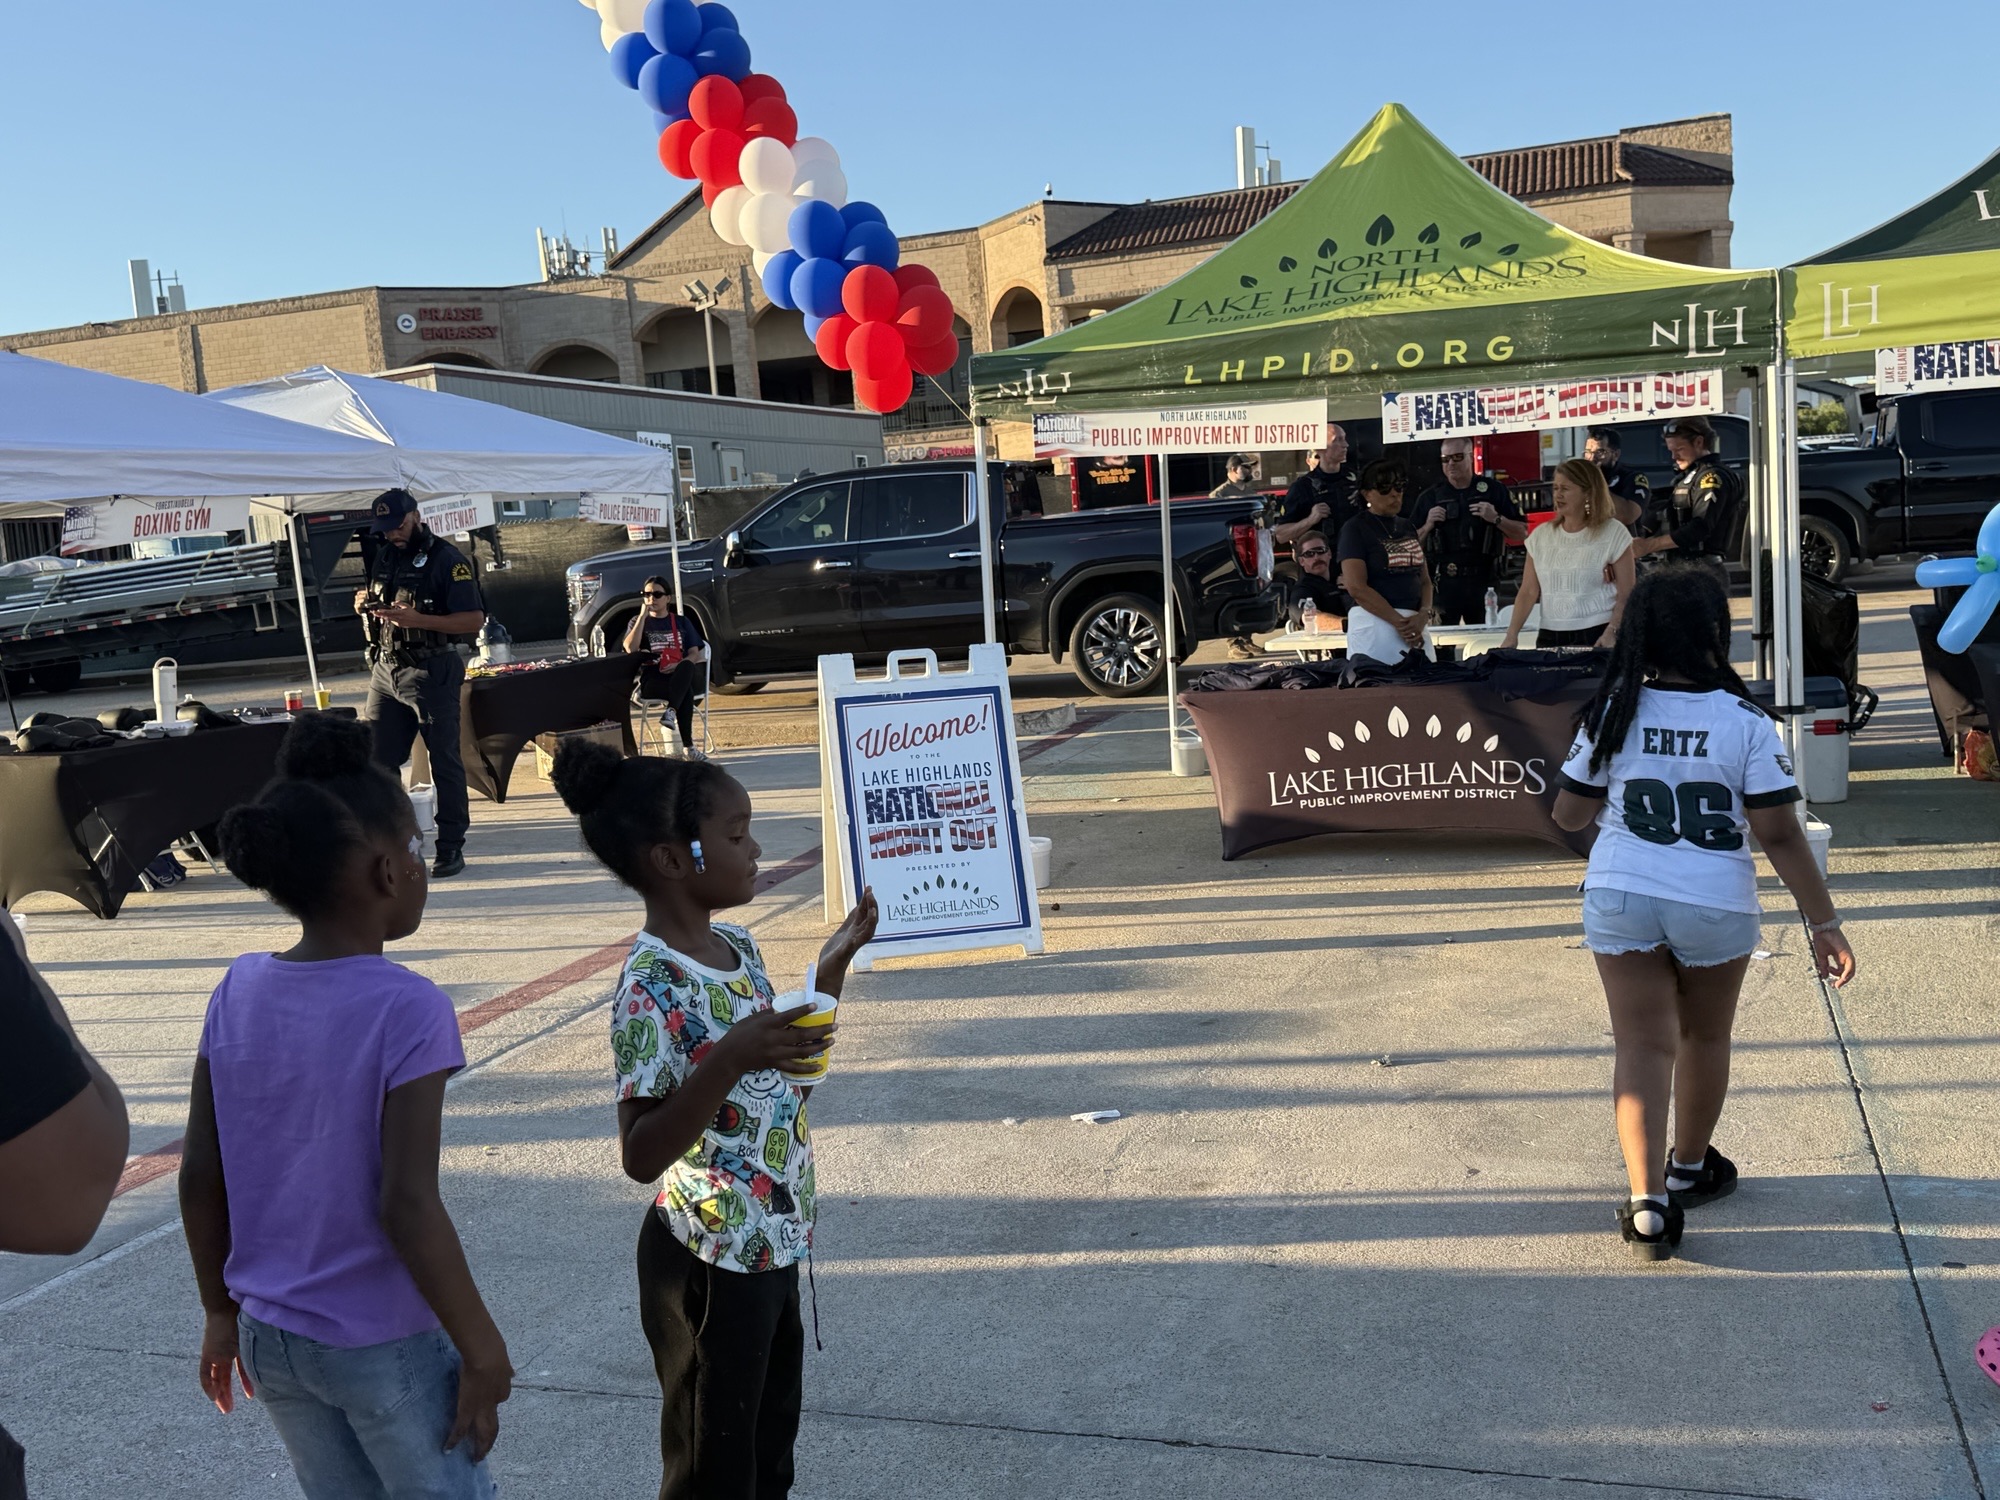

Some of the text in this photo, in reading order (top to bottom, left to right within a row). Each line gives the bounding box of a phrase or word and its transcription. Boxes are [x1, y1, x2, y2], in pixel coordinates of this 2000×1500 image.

[1310, 248, 1441, 279] NORTH
[1166, 254, 1588, 326] LAKE HIGHLANDS
[1207, 278, 1544, 325] PUBLIC IMPROVEMENT DISTRICT
[418, 306, 484, 321] PRAISE
[1820, 281, 1882, 341] LH
[421, 325, 498, 341] EMBASSY
[1649, 303, 1748, 359] NLH
[1184, 335, 1515, 385] LHPID.ORG
[1897, 346, 1908, 382] HIGHLAND
[1885, 366, 1895, 383] LAKE
[1415, 370, 1713, 431] NATIONAL NIGHT OUT
[1037, 417, 1081, 431] NATIONAL
[1160, 410, 1247, 422] NORTH LAKE HIGHLANDS
[1390, 418, 1398, 433] LAKE
[1037, 431, 1081, 444] NIGHT OUT
[1092, 427, 1142, 447] PUBLIC
[1147, 426, 1250, 446] IMPROVEMENT
[1255, 424, 1319, 444] DISTRICT
[884, 444, 927, 462] etro
[134, 508, 211, 537] BOXING GYM
[420, 507, 477, 534] ATHY STEWART
[600, 503, 620, 520] POLICE
[622, 505, 661, 523] DEPARTMENT
[740, 628, 793, 637] DENALI
[856, 704, 988, 759] Welcome!
[1642, 727, 1709, 757] ERTZ
[862, 761, 992, 786] LAKE HIGHLANDS
[1267, 758, 1547, 807] LAKE HIGHLANDS
[864, 780, 997, 824] NATIONAL
[1300, 789, 1517, 809] PUBLIC IMPROVEMENT DISTRICT
[1622, 778, 1744, 851] 86
[868, 816, 998, 859] NIGHT OUT
[905, 862, 957, 872] PRESENTED
[886, 894, 1000, 921] LAKE HIGHLANDS
[900, 909, 989, 923] PUBLIC IMPROVEMENT DISTRICT
[738, 1145, 760, 1162] BOO!
